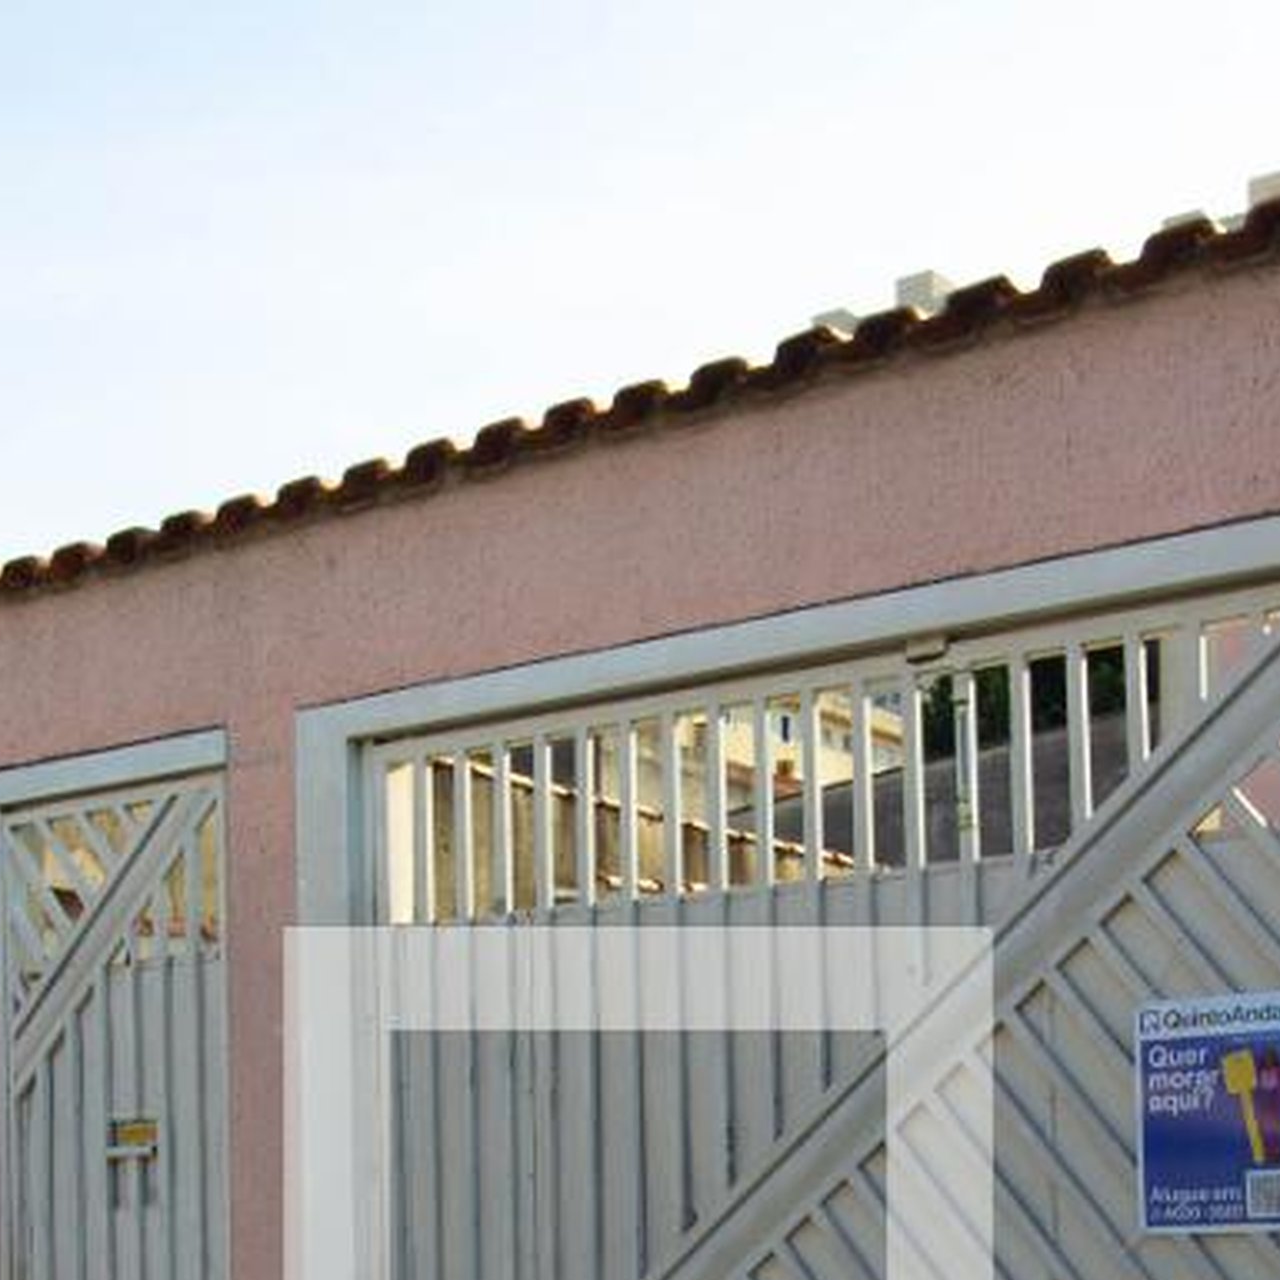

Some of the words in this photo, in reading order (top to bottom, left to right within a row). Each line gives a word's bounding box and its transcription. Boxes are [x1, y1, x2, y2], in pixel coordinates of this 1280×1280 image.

[1148, 1044, 1209, 1068] Quer
[1148, 1068, 1218, 1090] morar
[1148, 1087, 1215, 1116] aqui?
